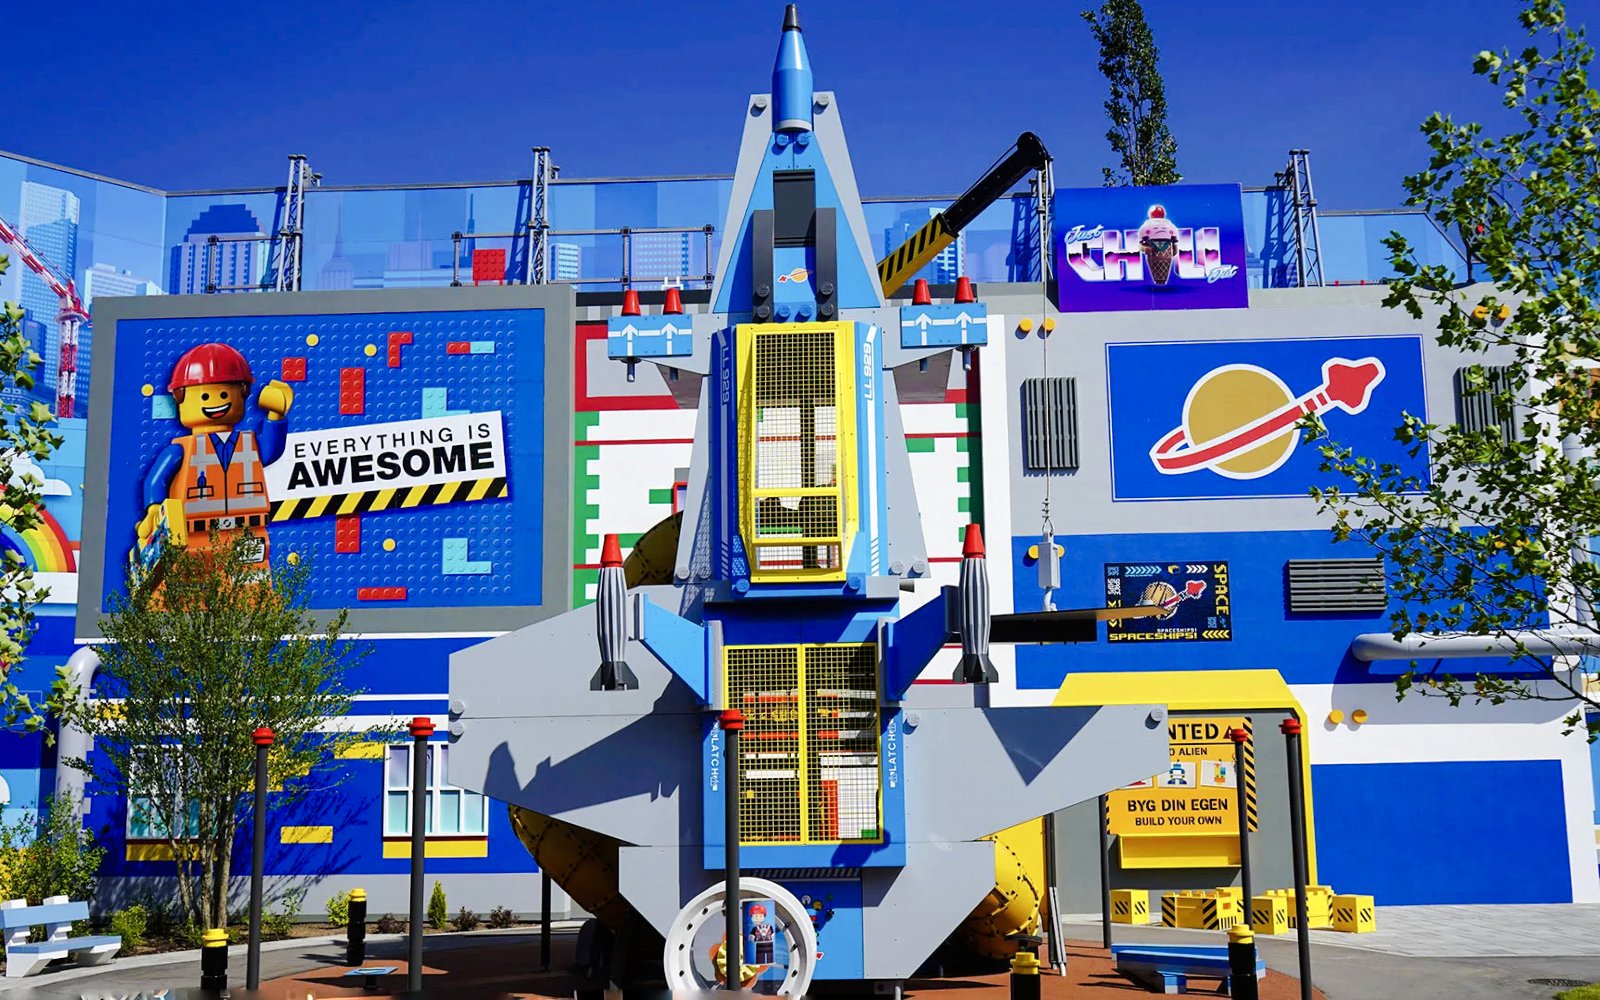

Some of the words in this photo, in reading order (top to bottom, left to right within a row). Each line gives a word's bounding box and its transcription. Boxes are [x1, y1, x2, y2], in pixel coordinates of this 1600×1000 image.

[1064, 224, 1105, 244] Just
[1207, 264, 1239, 284] Out
[294, 427, 453, 459] EVERYTHING
[468, 423, 491, 440] IS
[287, 441, 495, 491] AWESOME
[1213, 564, 1230, 615] SPACE
[1109, 632, 1198, 641] SPACESHIPS!
[711, 737, 719, 775] LATCH
[888, 734, 896, 771] LATCH
[1178, 747, 1208, 756] ALIEN
[1127, 799, 1156, 812] BYG
[1161, 799, 1186, 811] DIN
[1191, 798, 1228, 811] EGEN
[1135, 817, 1165, 826] BUILD
[1167, 816, 1195, 826] YOUR
[1197, 816, 1222, 825] OWN
